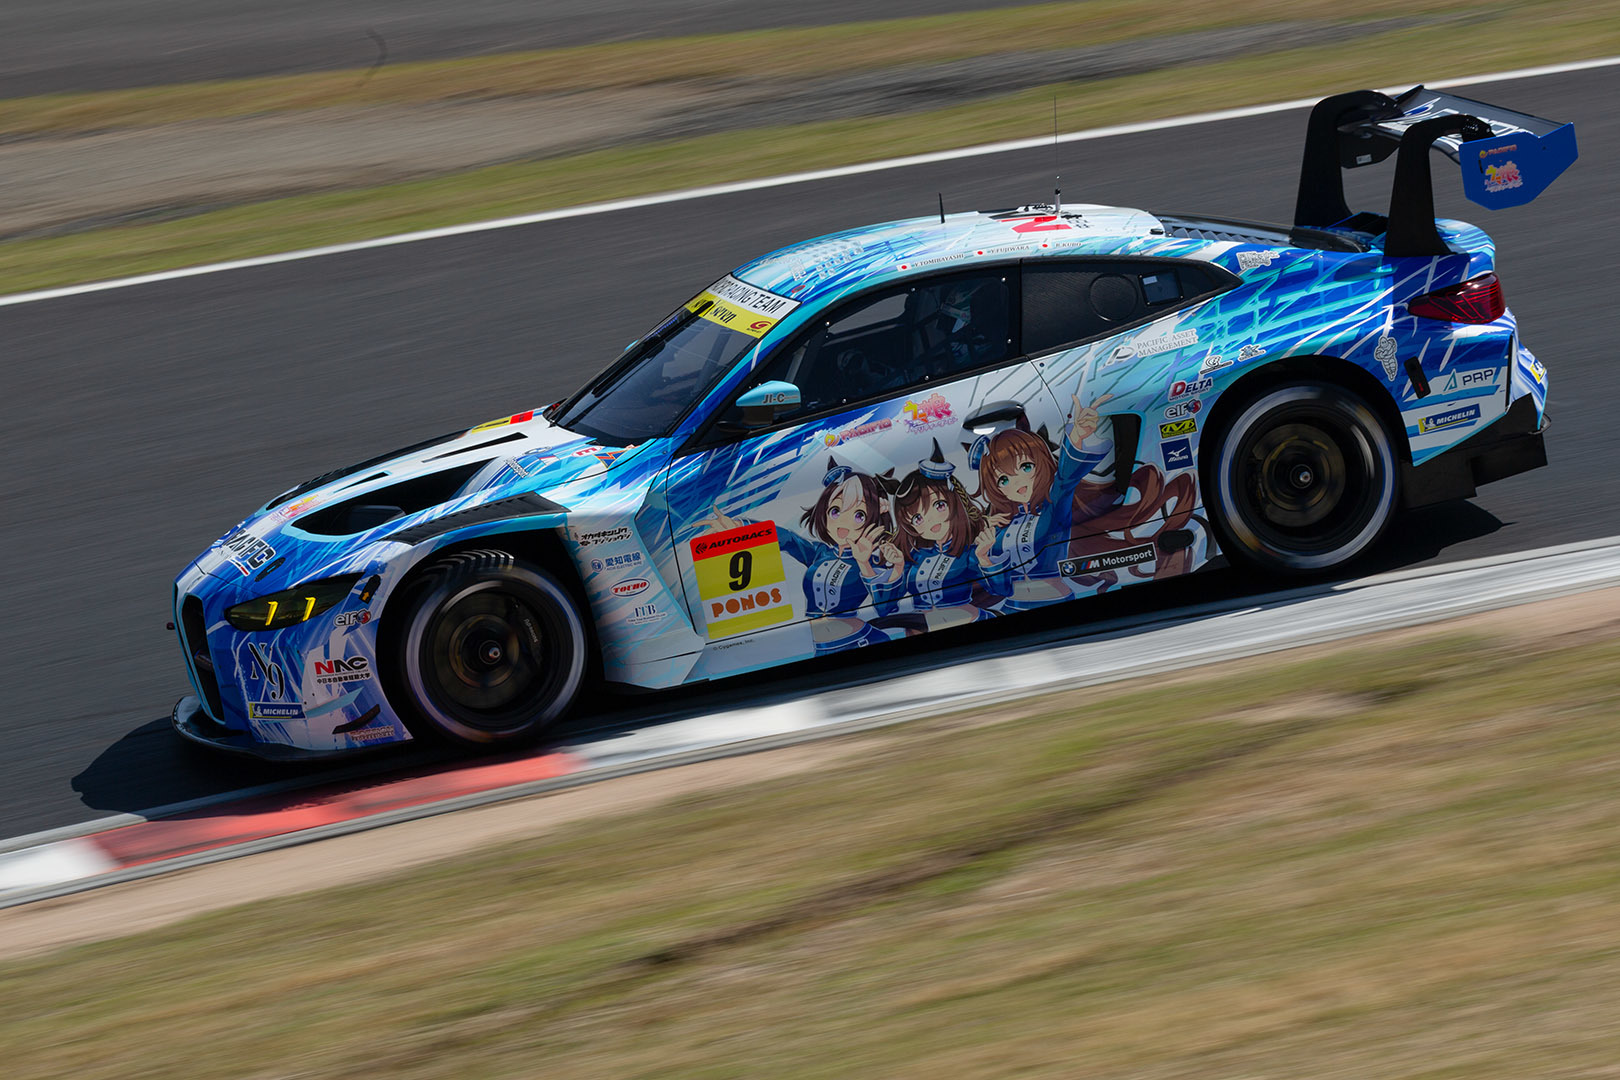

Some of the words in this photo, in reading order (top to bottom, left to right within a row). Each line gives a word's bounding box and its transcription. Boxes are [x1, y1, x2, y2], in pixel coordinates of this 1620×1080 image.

[750, 294, 786, 314] TEAM
[1137, 336, 1168, 349] PACIFIC
[1173, 330, 1196, 341] ASSET
[1138, 337, 1197, 356] MANAGEMENT
[1462, 369, 1494, 386] PRP
[1171, 378, 1212, 397] DELTA
[763, 393, 785, 404] JI-C
[904, 393, 952, 423] ウマ娘
[1166, 401, 1188, 418] elf
[1436, 409, 1476, 425] MICHELIN
[708, 528, 773, 550] AUTOBACS
[605, 552, 642, 567] 愛知電線
[1103, 549, 1152, 566] Motorsport
[729, 551, 752, 591] 9
[711, 588, 782, 618] PONOS
[335, 612, 357, 626] elf
[314, 657, 369, 675] NAC
[263, 708, 299, 716] MICHELIN
